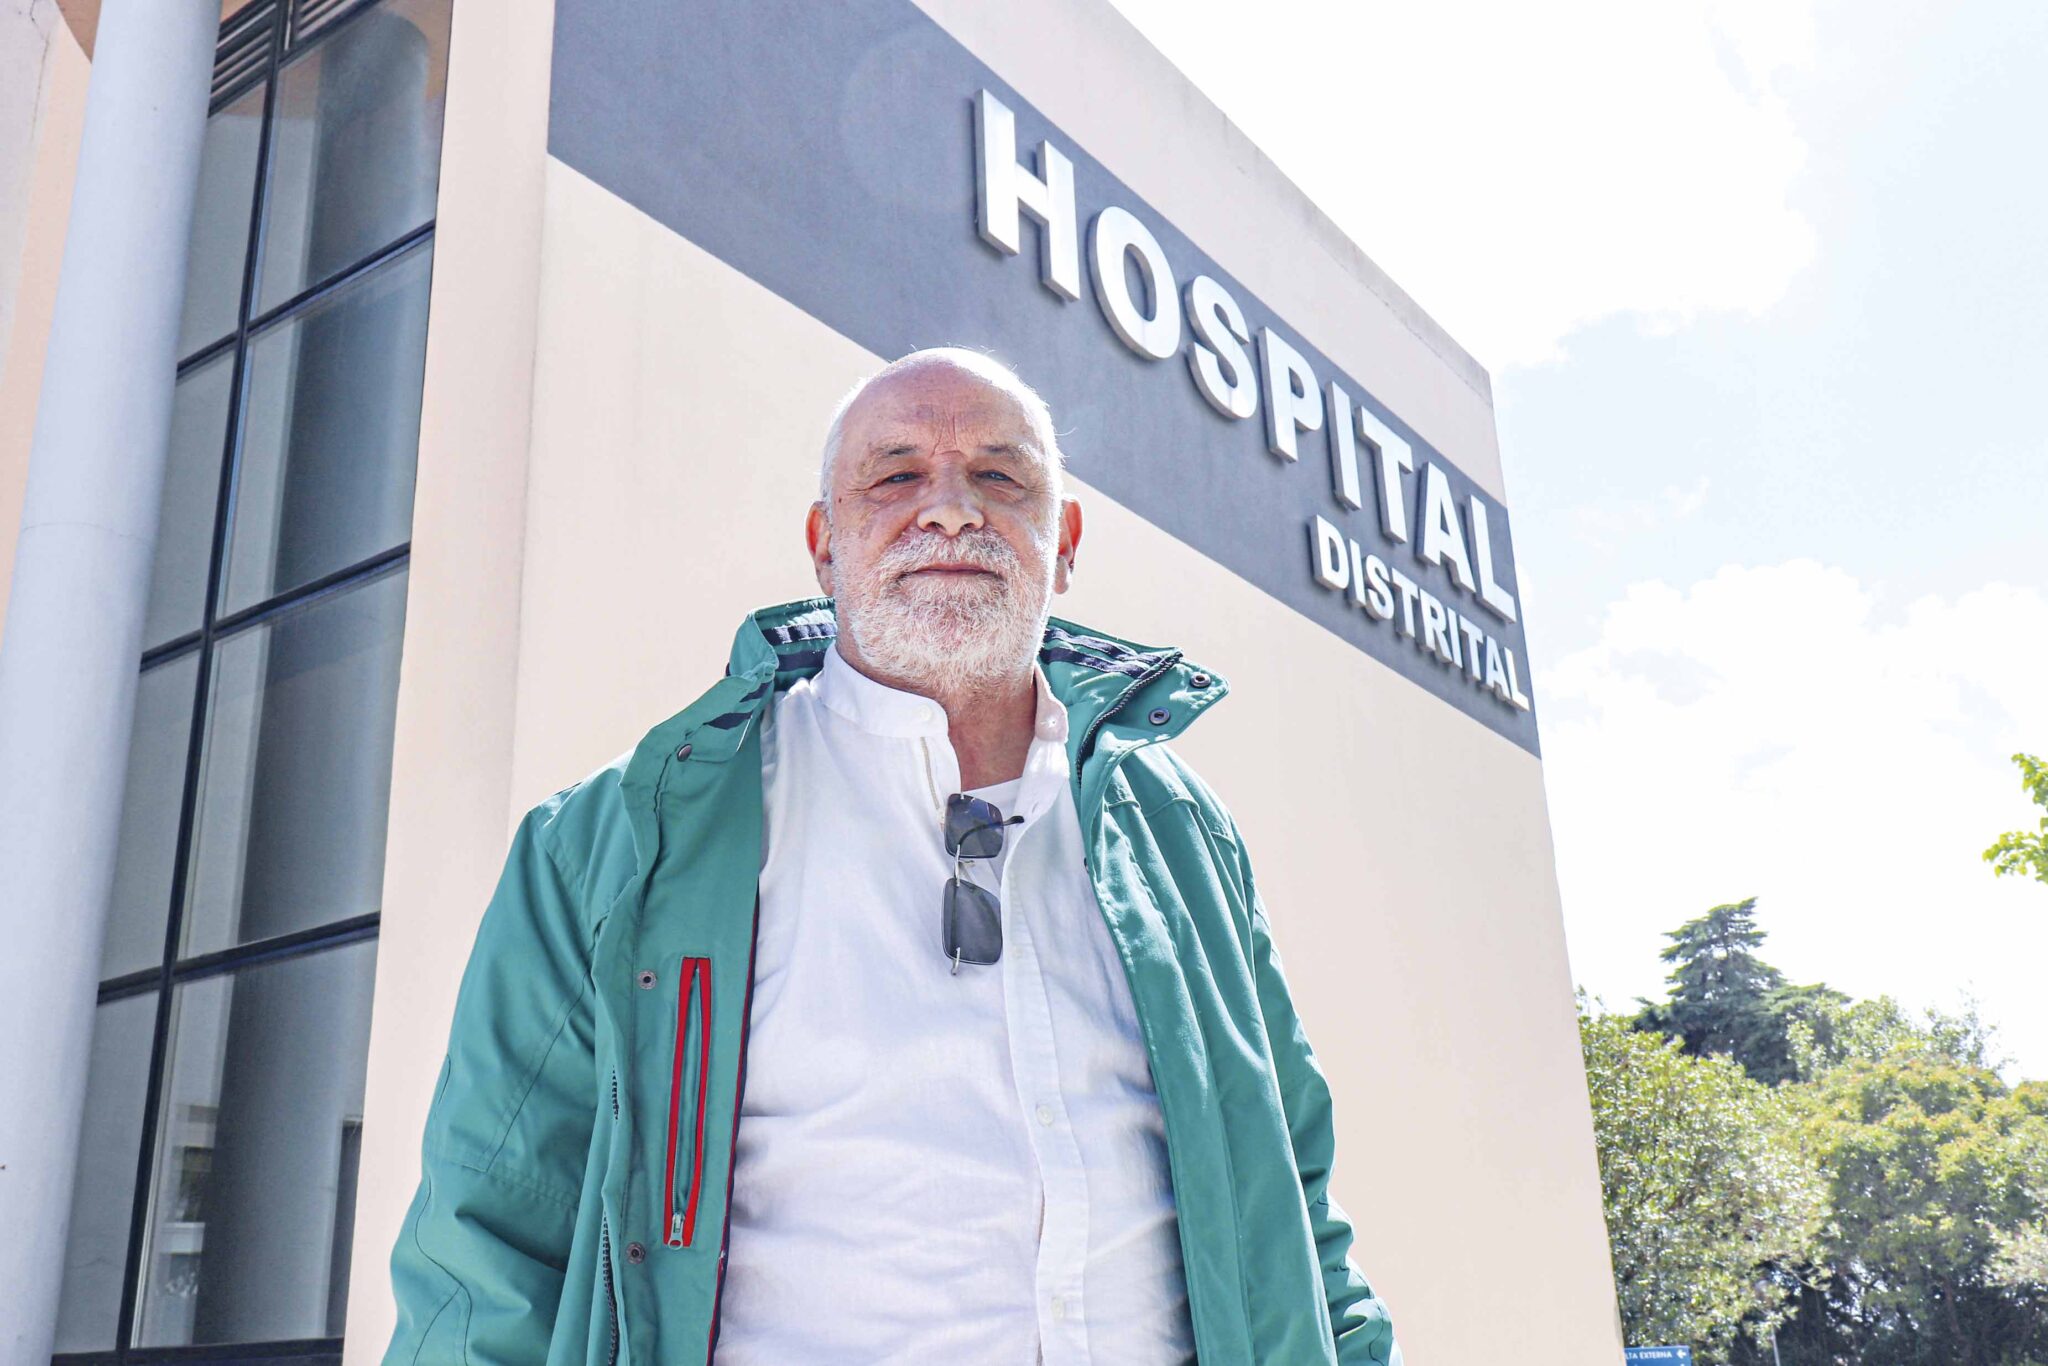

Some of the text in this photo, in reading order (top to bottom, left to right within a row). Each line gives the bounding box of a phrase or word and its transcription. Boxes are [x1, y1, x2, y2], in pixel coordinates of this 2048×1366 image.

[974, 88, 1516, 624] HOSPITAL
[1309, 514, 1530, 713] DISTRITAL
[1640, 1350, 1673, 1360] EXTERNA
